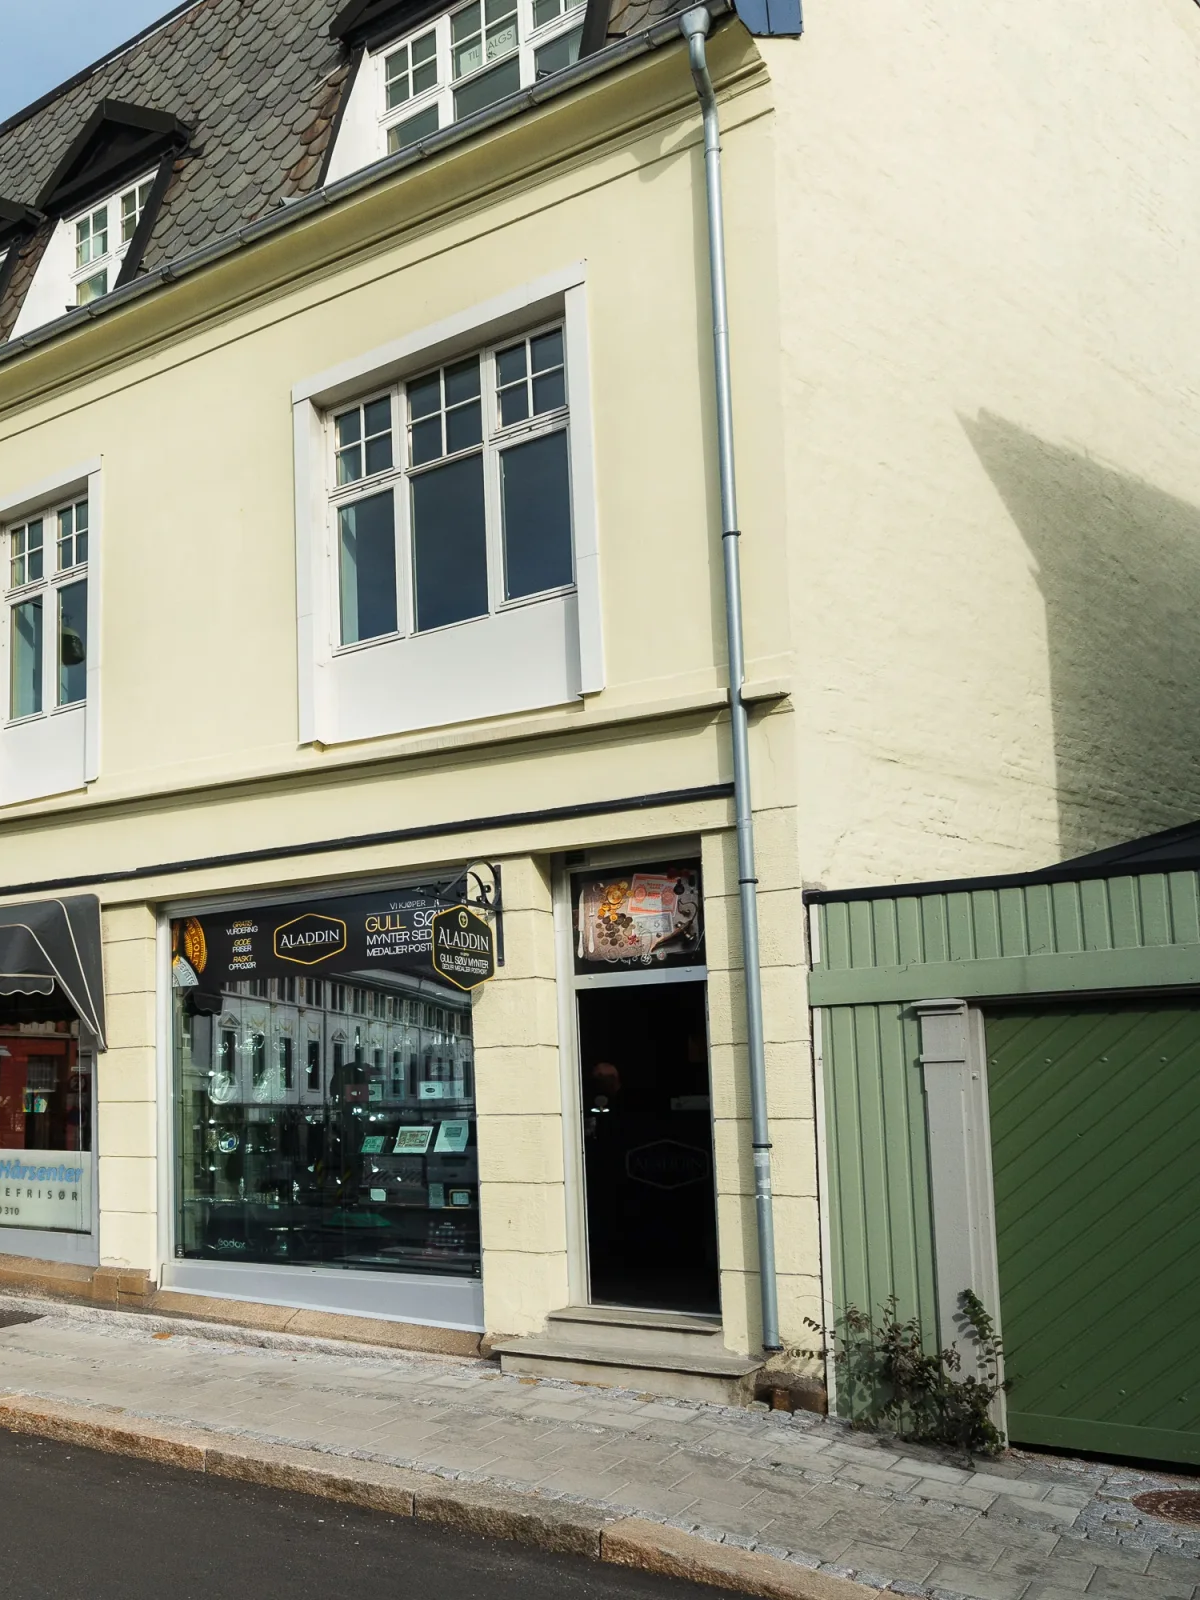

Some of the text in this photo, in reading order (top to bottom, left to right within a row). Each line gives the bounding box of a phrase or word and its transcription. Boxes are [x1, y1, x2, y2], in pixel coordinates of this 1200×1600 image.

[468, 30, 513, 62] TIL ALGS
[398, 899, 426, 909] KJØPER
[232, 919, 253, 929] GRATIS
[365, 909, 445, 932] GULL SØ
[226, 925, 259, 936] VURDERING
[234, 937, 252, 946] GODE
[280, 929, 340, 948] ALADDIN
[366, 929, 433, 946] MYNTER SED
[438, 926, 490, 952] ALADDIN
[232, 944, 252, 954] PRISER
[366, 944, 408, 957] MEDALJER
[233, 954, 253, 963] RASKT
[440, 953, 454, 964] GULL
[454, 955, 468, 966] SØLV
[468, 957, 489, 969] MYNTER
[228, 961, 257, 971] OPPGJØR
[4, 1206, 20, 1216] 310
